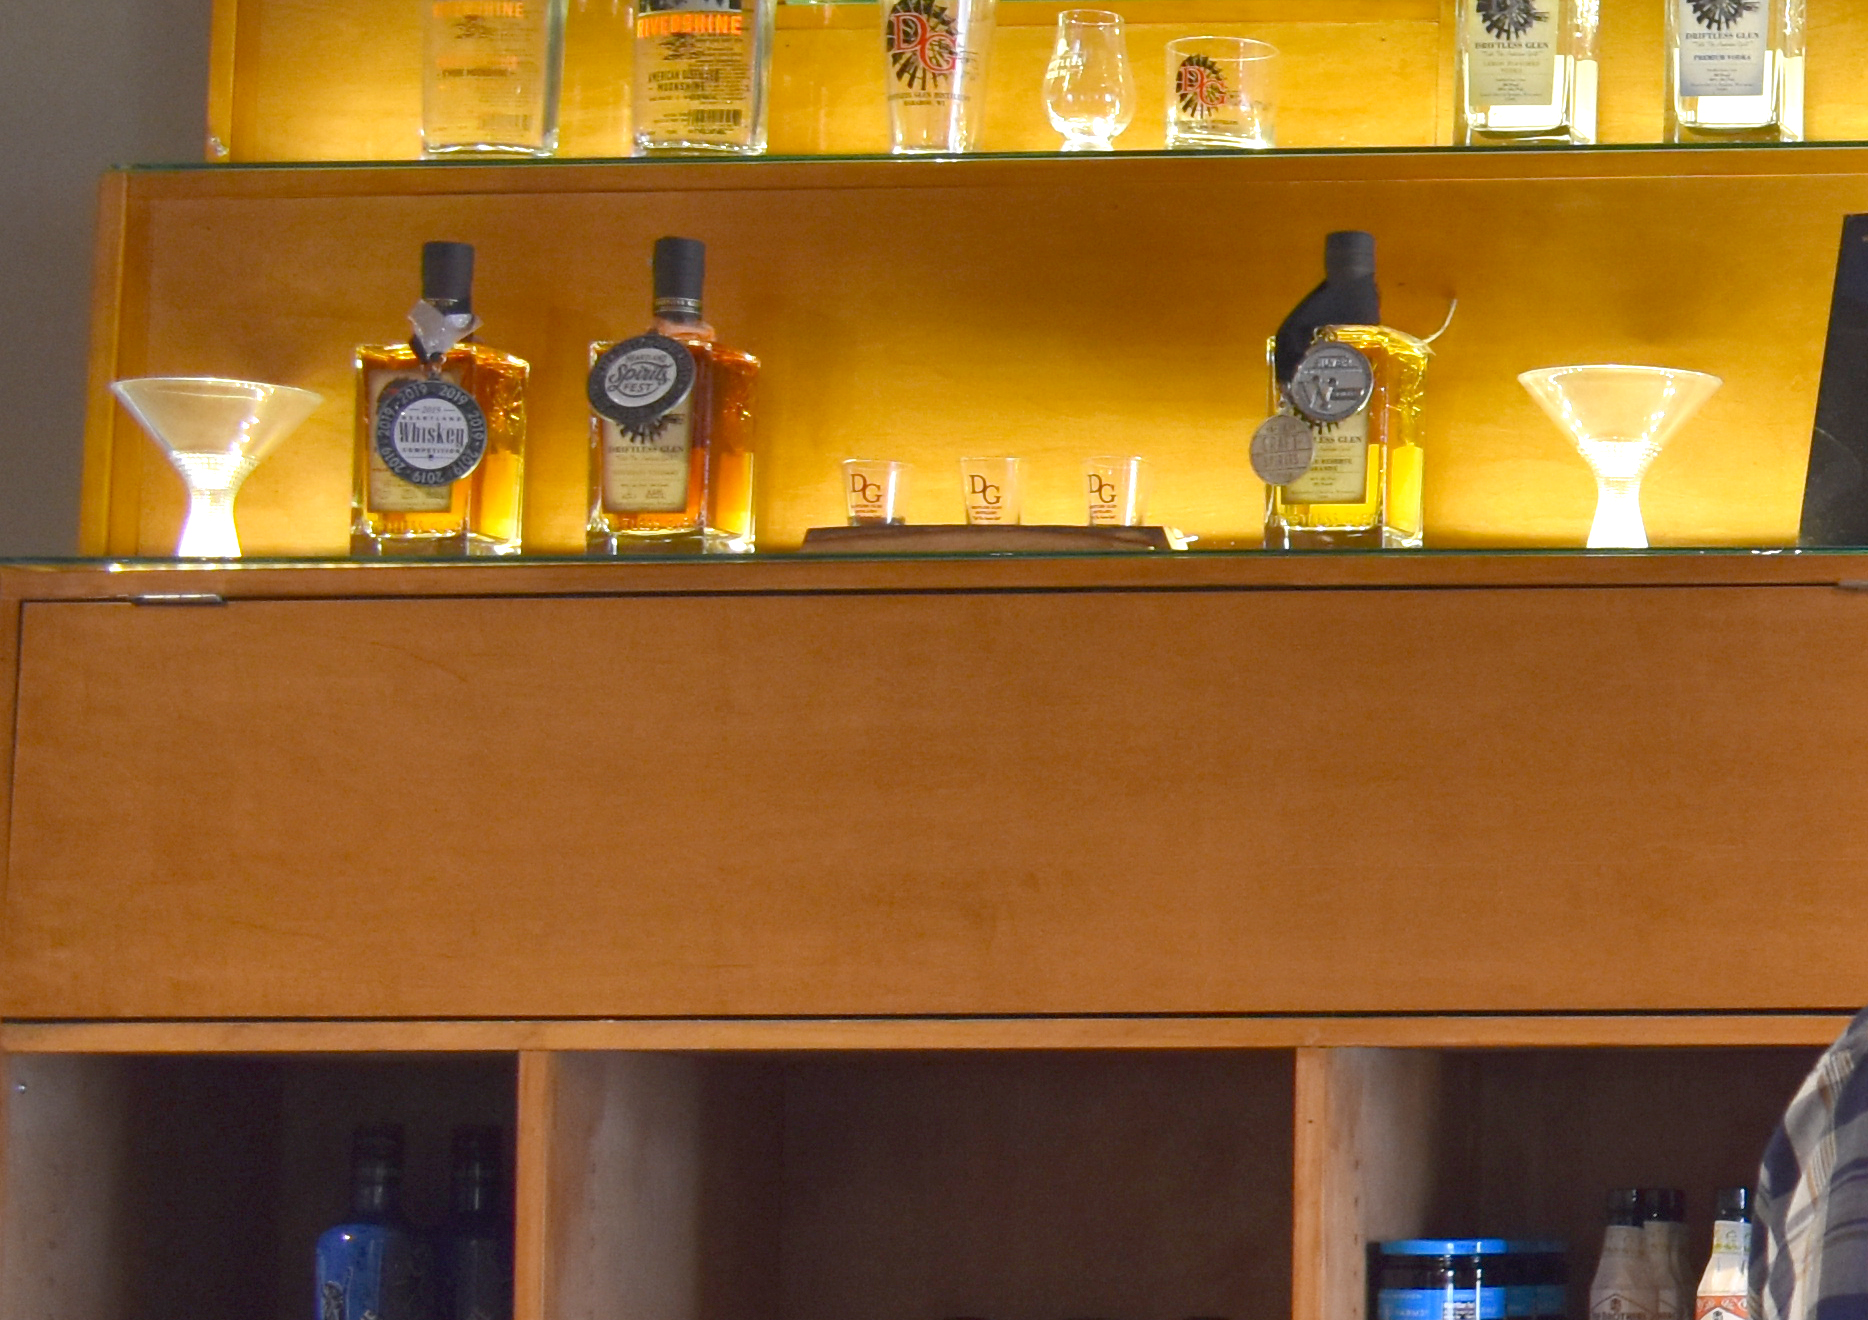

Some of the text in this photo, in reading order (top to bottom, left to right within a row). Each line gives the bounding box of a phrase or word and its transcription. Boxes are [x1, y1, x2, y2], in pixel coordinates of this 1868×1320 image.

[892, 12, 959, 74] DG
[609, 361, 669, 392] Spirits
[624, 380, 652, 393] FEST
[399, 421, 468, 448] Whiskey
[850, 473, 883, 504] DG
[968, 474, 1002, 505] DG
[1087, 473, 1117, 504] DG
